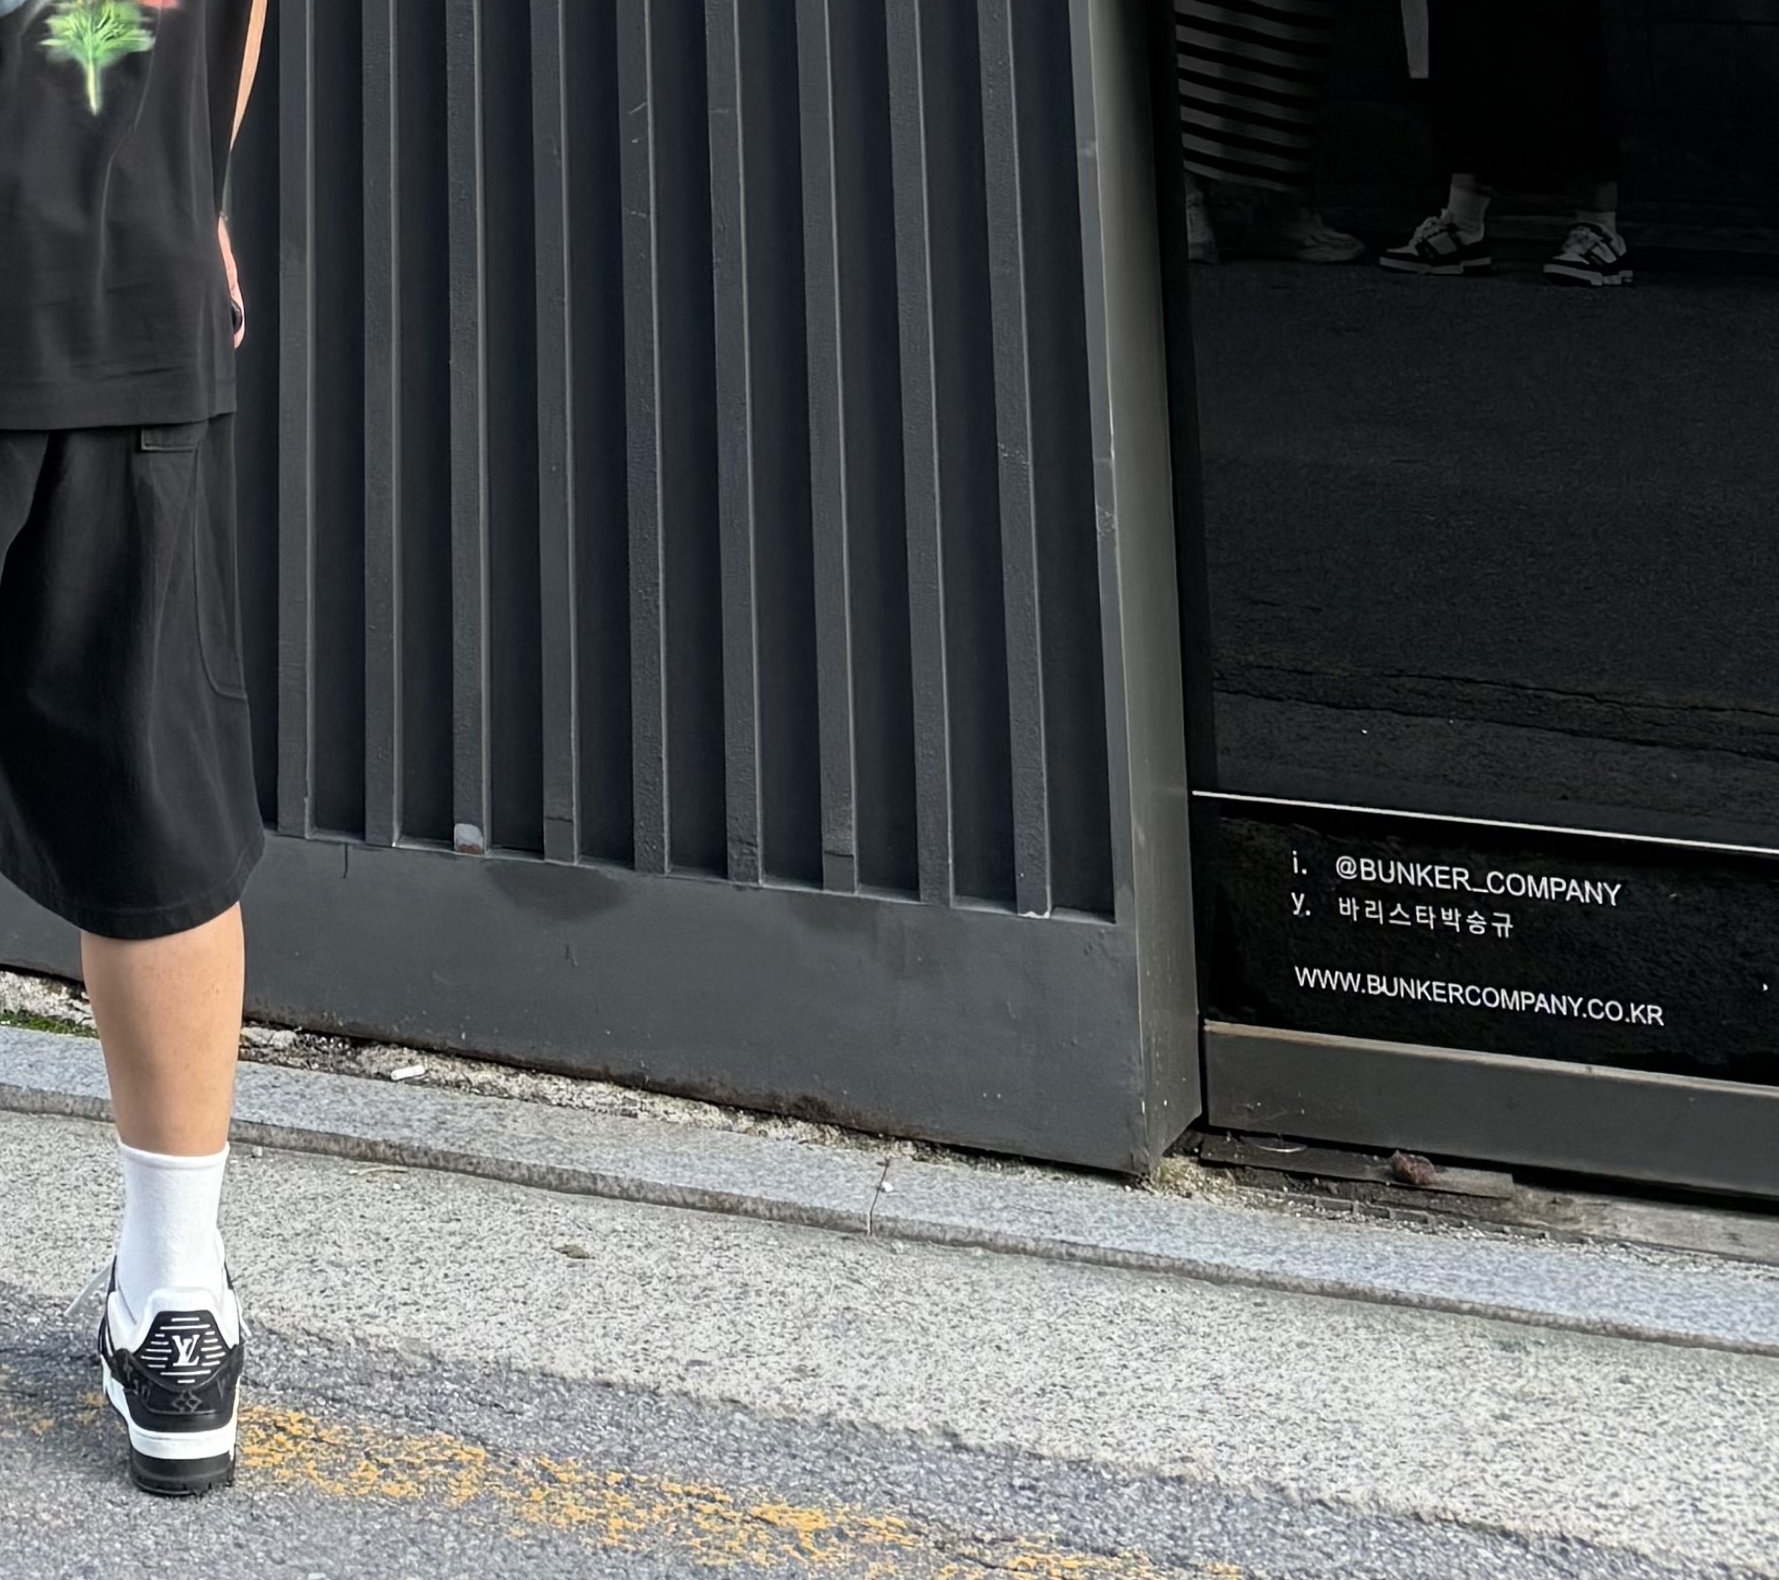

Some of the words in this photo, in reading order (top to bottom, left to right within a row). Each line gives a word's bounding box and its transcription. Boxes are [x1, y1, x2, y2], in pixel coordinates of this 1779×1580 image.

[1336, 855, 1622, 907] @BUNKER_COMPANY
[1338, 897, 1514, 939] 바리스타박승규
[1294, 965, 1664, 1027] WWW.BUNKERCOMPANY.CO.KR
